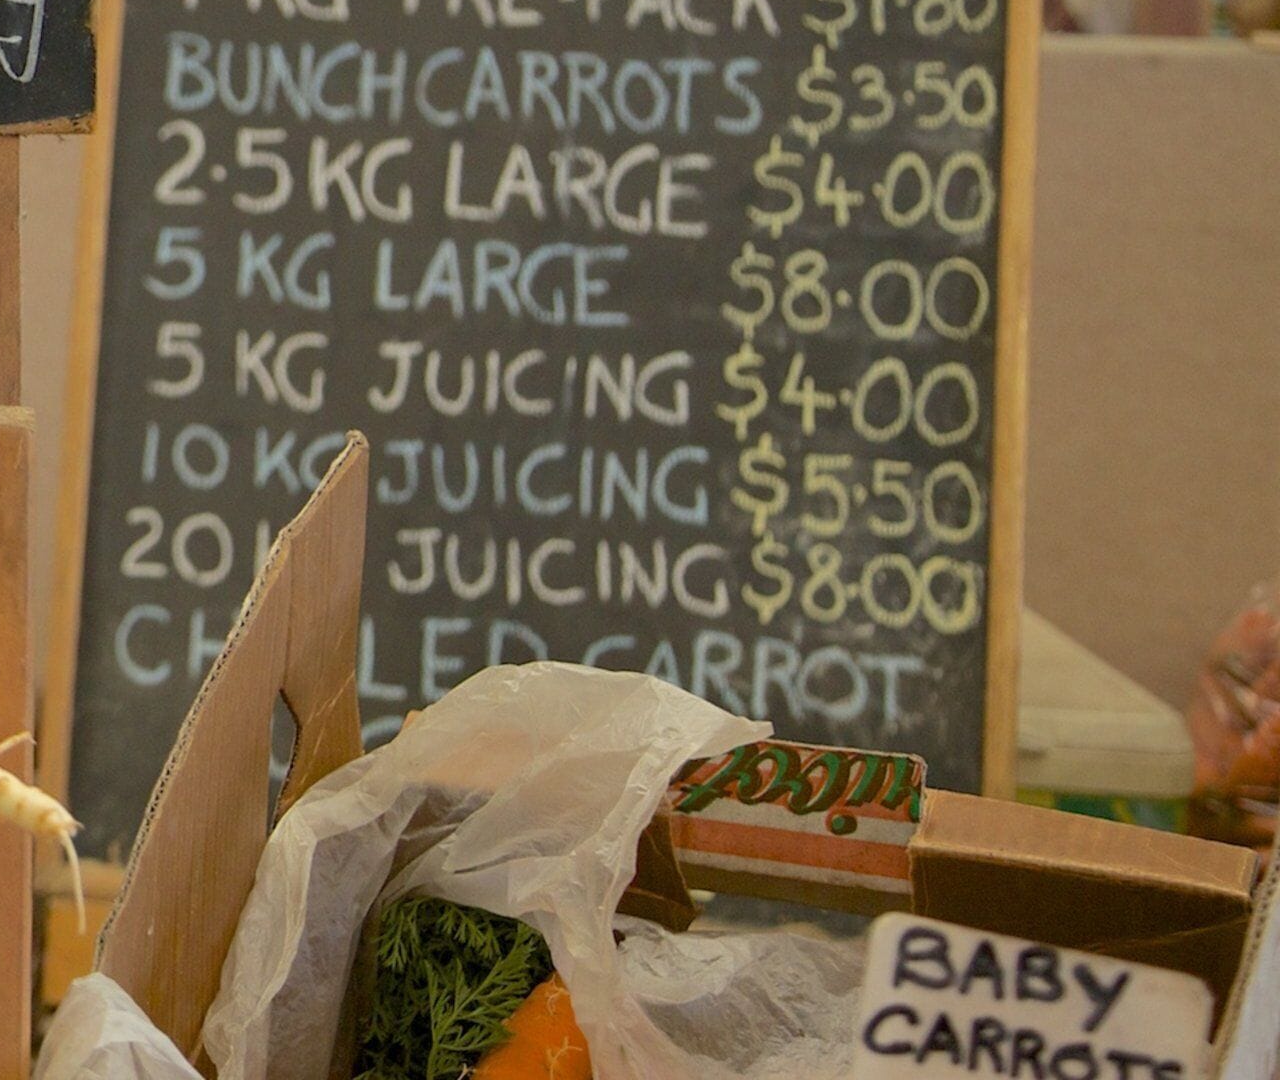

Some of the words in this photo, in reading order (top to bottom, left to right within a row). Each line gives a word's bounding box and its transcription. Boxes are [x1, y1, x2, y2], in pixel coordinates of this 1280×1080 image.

[790, 44, 998, 147] $3.50
[443, 139, 714, 238] LARGE
[746, 134, 996, 239] $4.00
[142, 225, 207, 301] 5
[237, 229, 336, 311] KG
[374, 239, 630, 327] LARGE
[722, 240, 990, 341] $8.00
[147, 320, 206, 399] 5
[235, 329, 330, 414] KG
[367, 339, 694, 427] JUICING
[715, 340, 979, 449] $4.00
[141, 421, 230, 491] 10
[376, 437, 710, 528] JUICING
[730, 431, 984, 543] $5.50
[120, 505, 235, 589] 20
[386, 525, 731, 618] JUICING
[741, 529, 982, 634] $8.00
[893, 925, 1133, 1032] BABY
